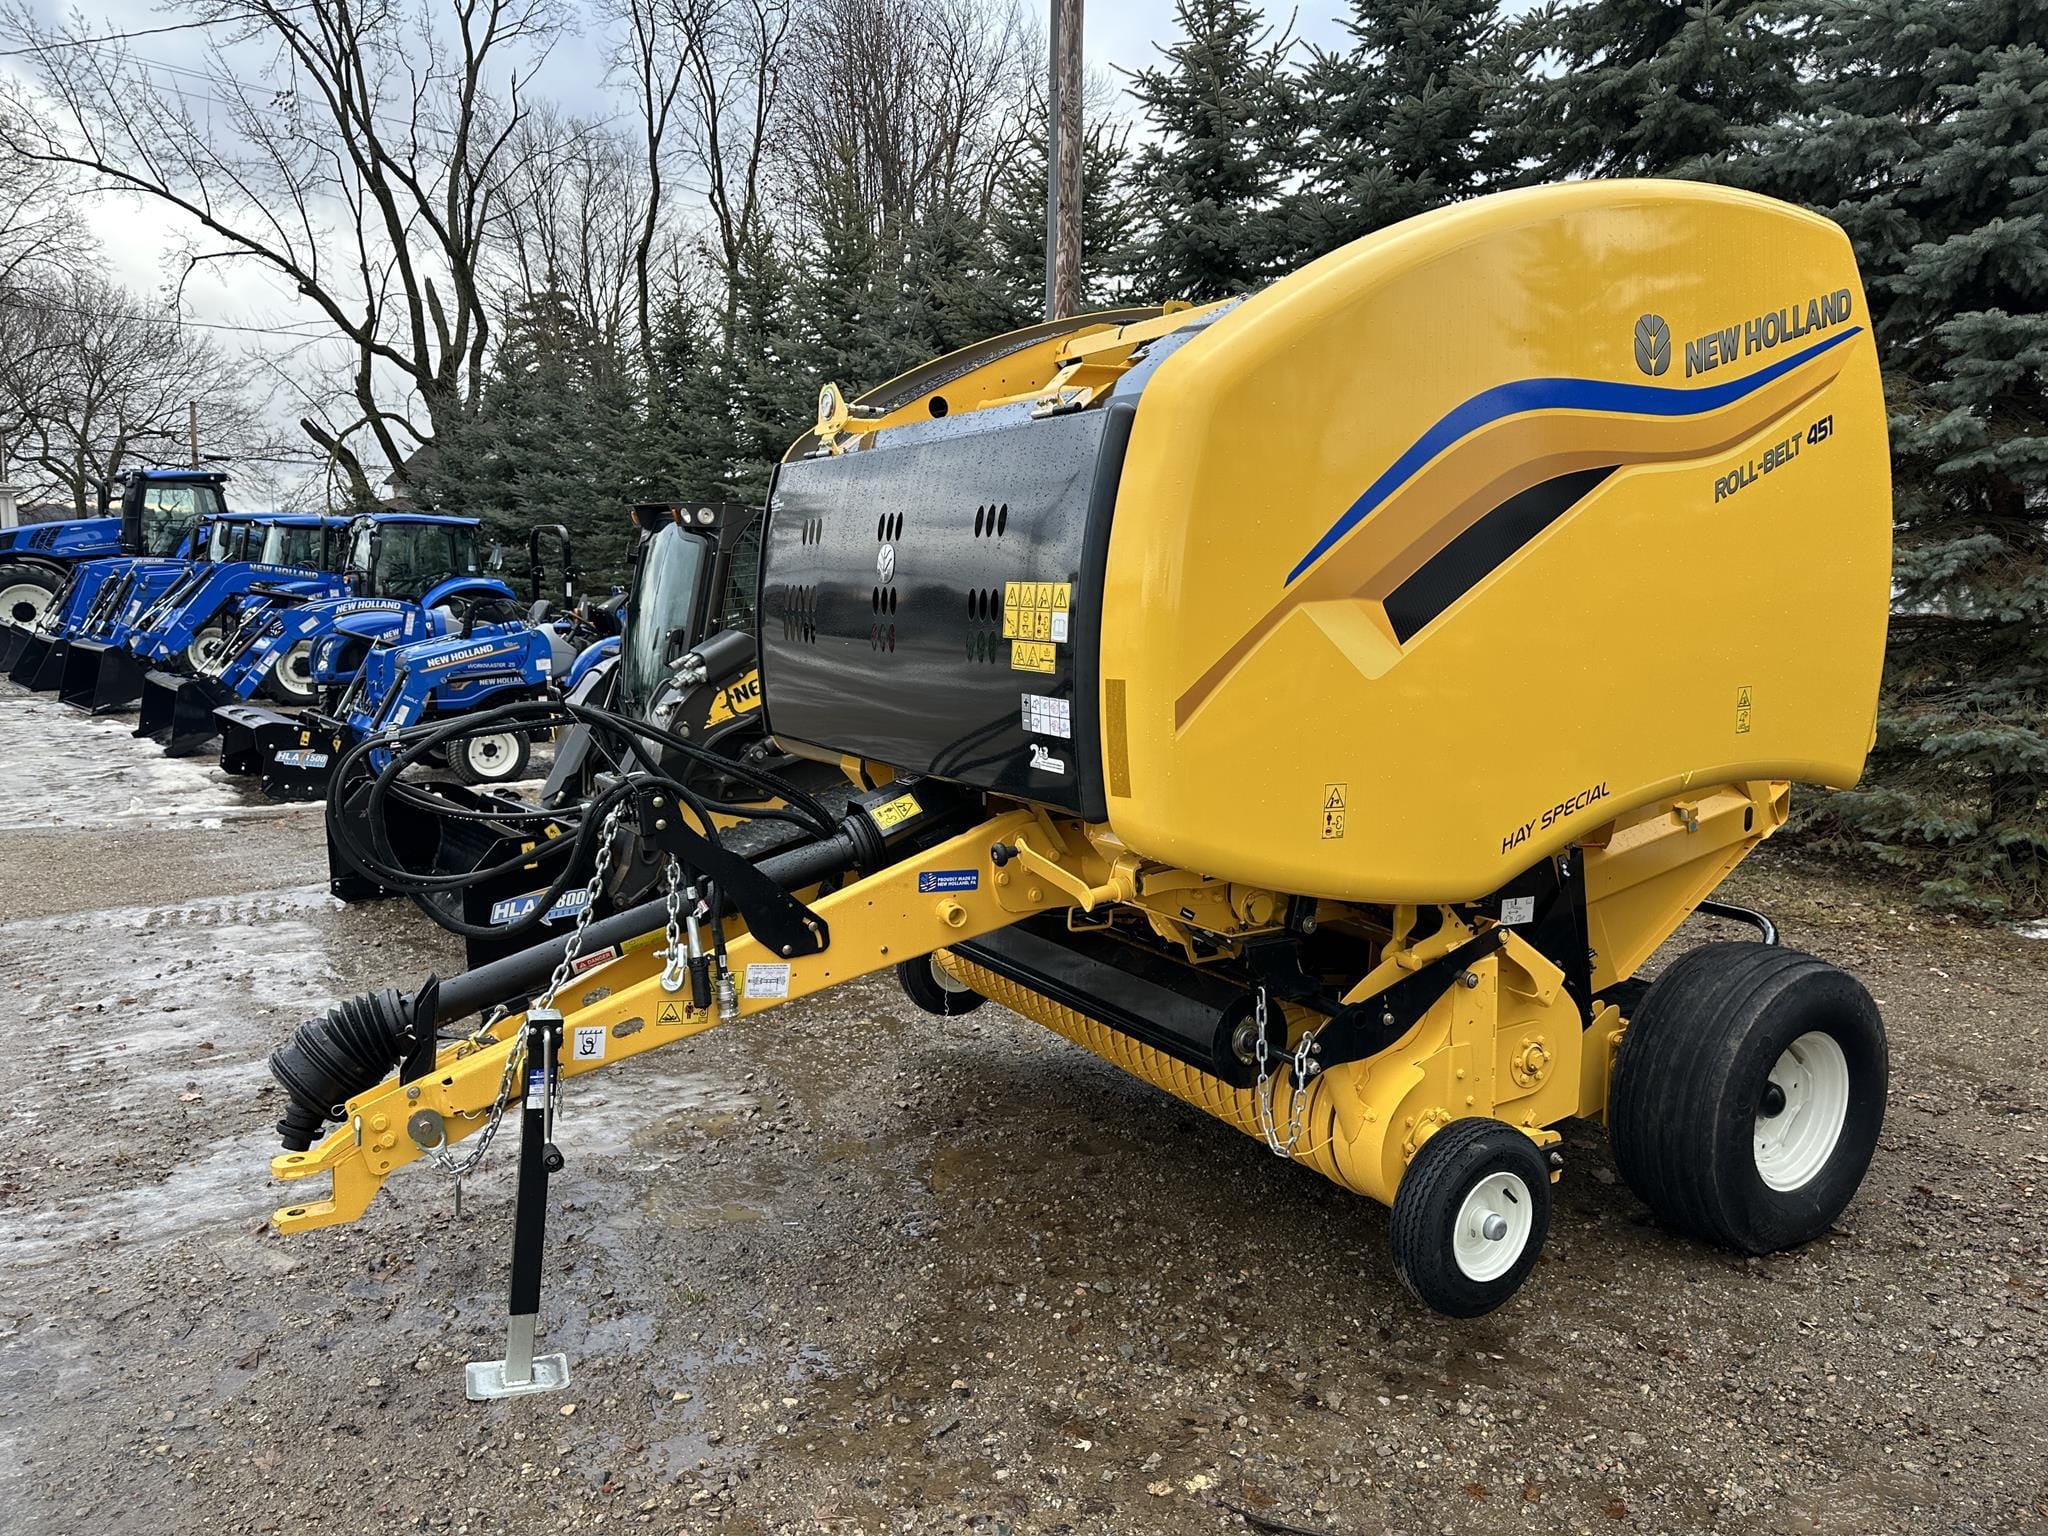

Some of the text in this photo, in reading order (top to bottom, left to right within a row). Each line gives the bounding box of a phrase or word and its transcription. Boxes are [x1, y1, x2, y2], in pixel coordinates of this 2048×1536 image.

[1685, 288, 1852, 378] NEW HOLLAND
[1714, 414, 1833, 504] ROLL-BELT 451
[249, 563, 319, 580] NEW HOLLAND
[335, 600, 401, 614] NEW HOLLAND
[383, 628, 400, 640] NEW
[427, 654, 449, 668] NEW
[450, 644, 494, 662] HOLLAND
[479, 676, 524, 686] NEW HOLLAN
[733, 679, 761, 704] NE
[278, 753, 327, 763] HLA 1500
[1501, 781, 1610, 855] HAY SPECIAL
[493, 899, 536, 920] HLA
[551, 890, 586, 909] 800
[586, 952, 612, 966] DANGER
